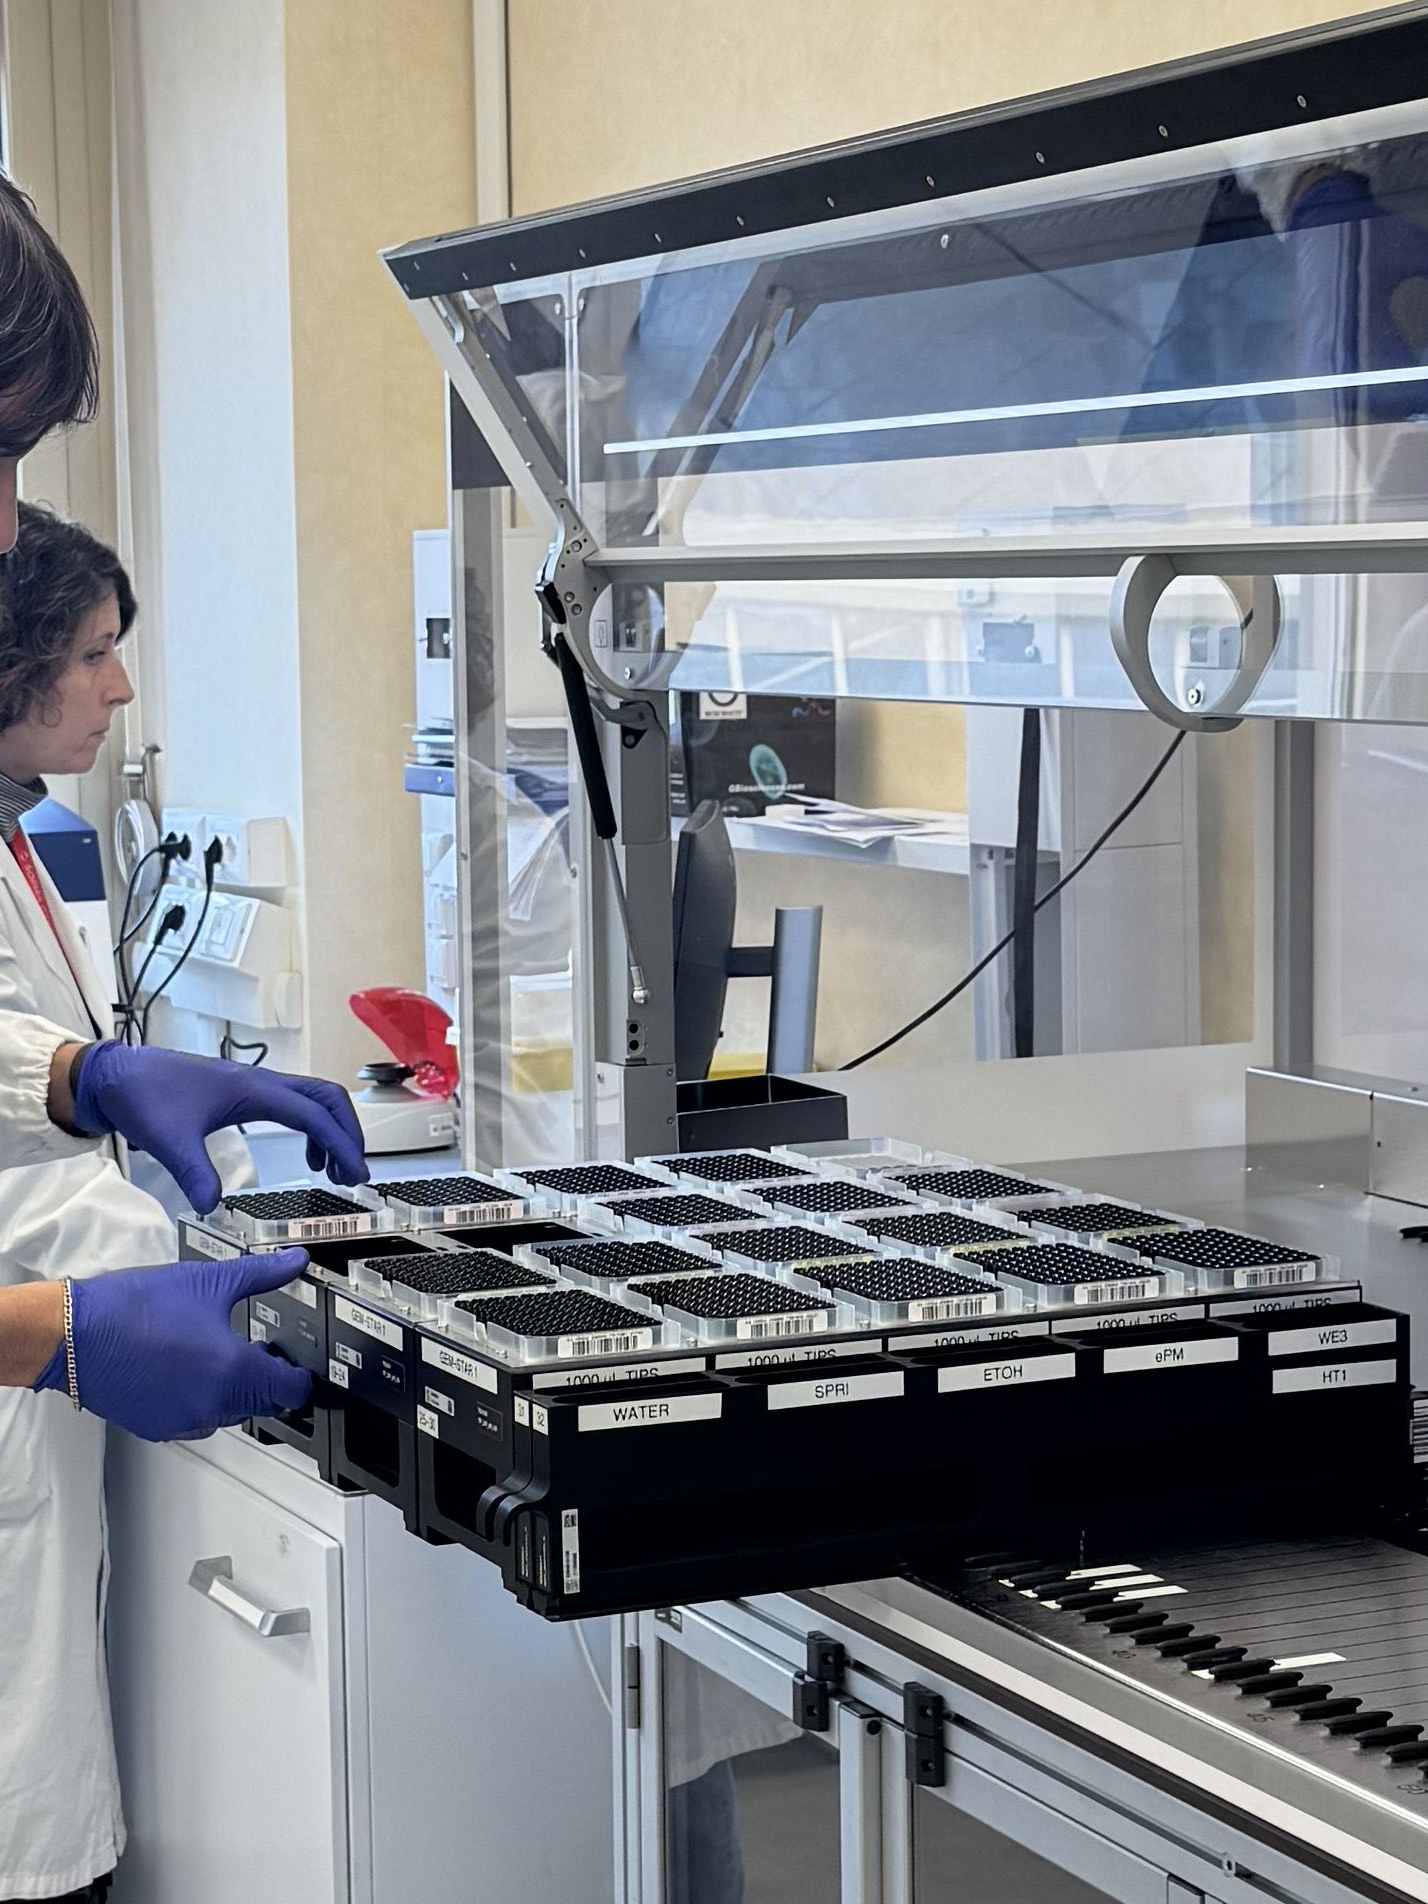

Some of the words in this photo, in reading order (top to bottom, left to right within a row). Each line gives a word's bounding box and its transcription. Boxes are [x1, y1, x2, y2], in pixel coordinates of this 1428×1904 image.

[1318, 1330, 1348, 1345] WE3
[1155, 1348, 1184, 1363] ePM
[983, 1366, 1023, 1382] ETOH
[1323, 1370, 1347, 1384] HT1
[815, 1383, 849, 1399] SPRI
[613, 1404, 670, 1422] WATER
